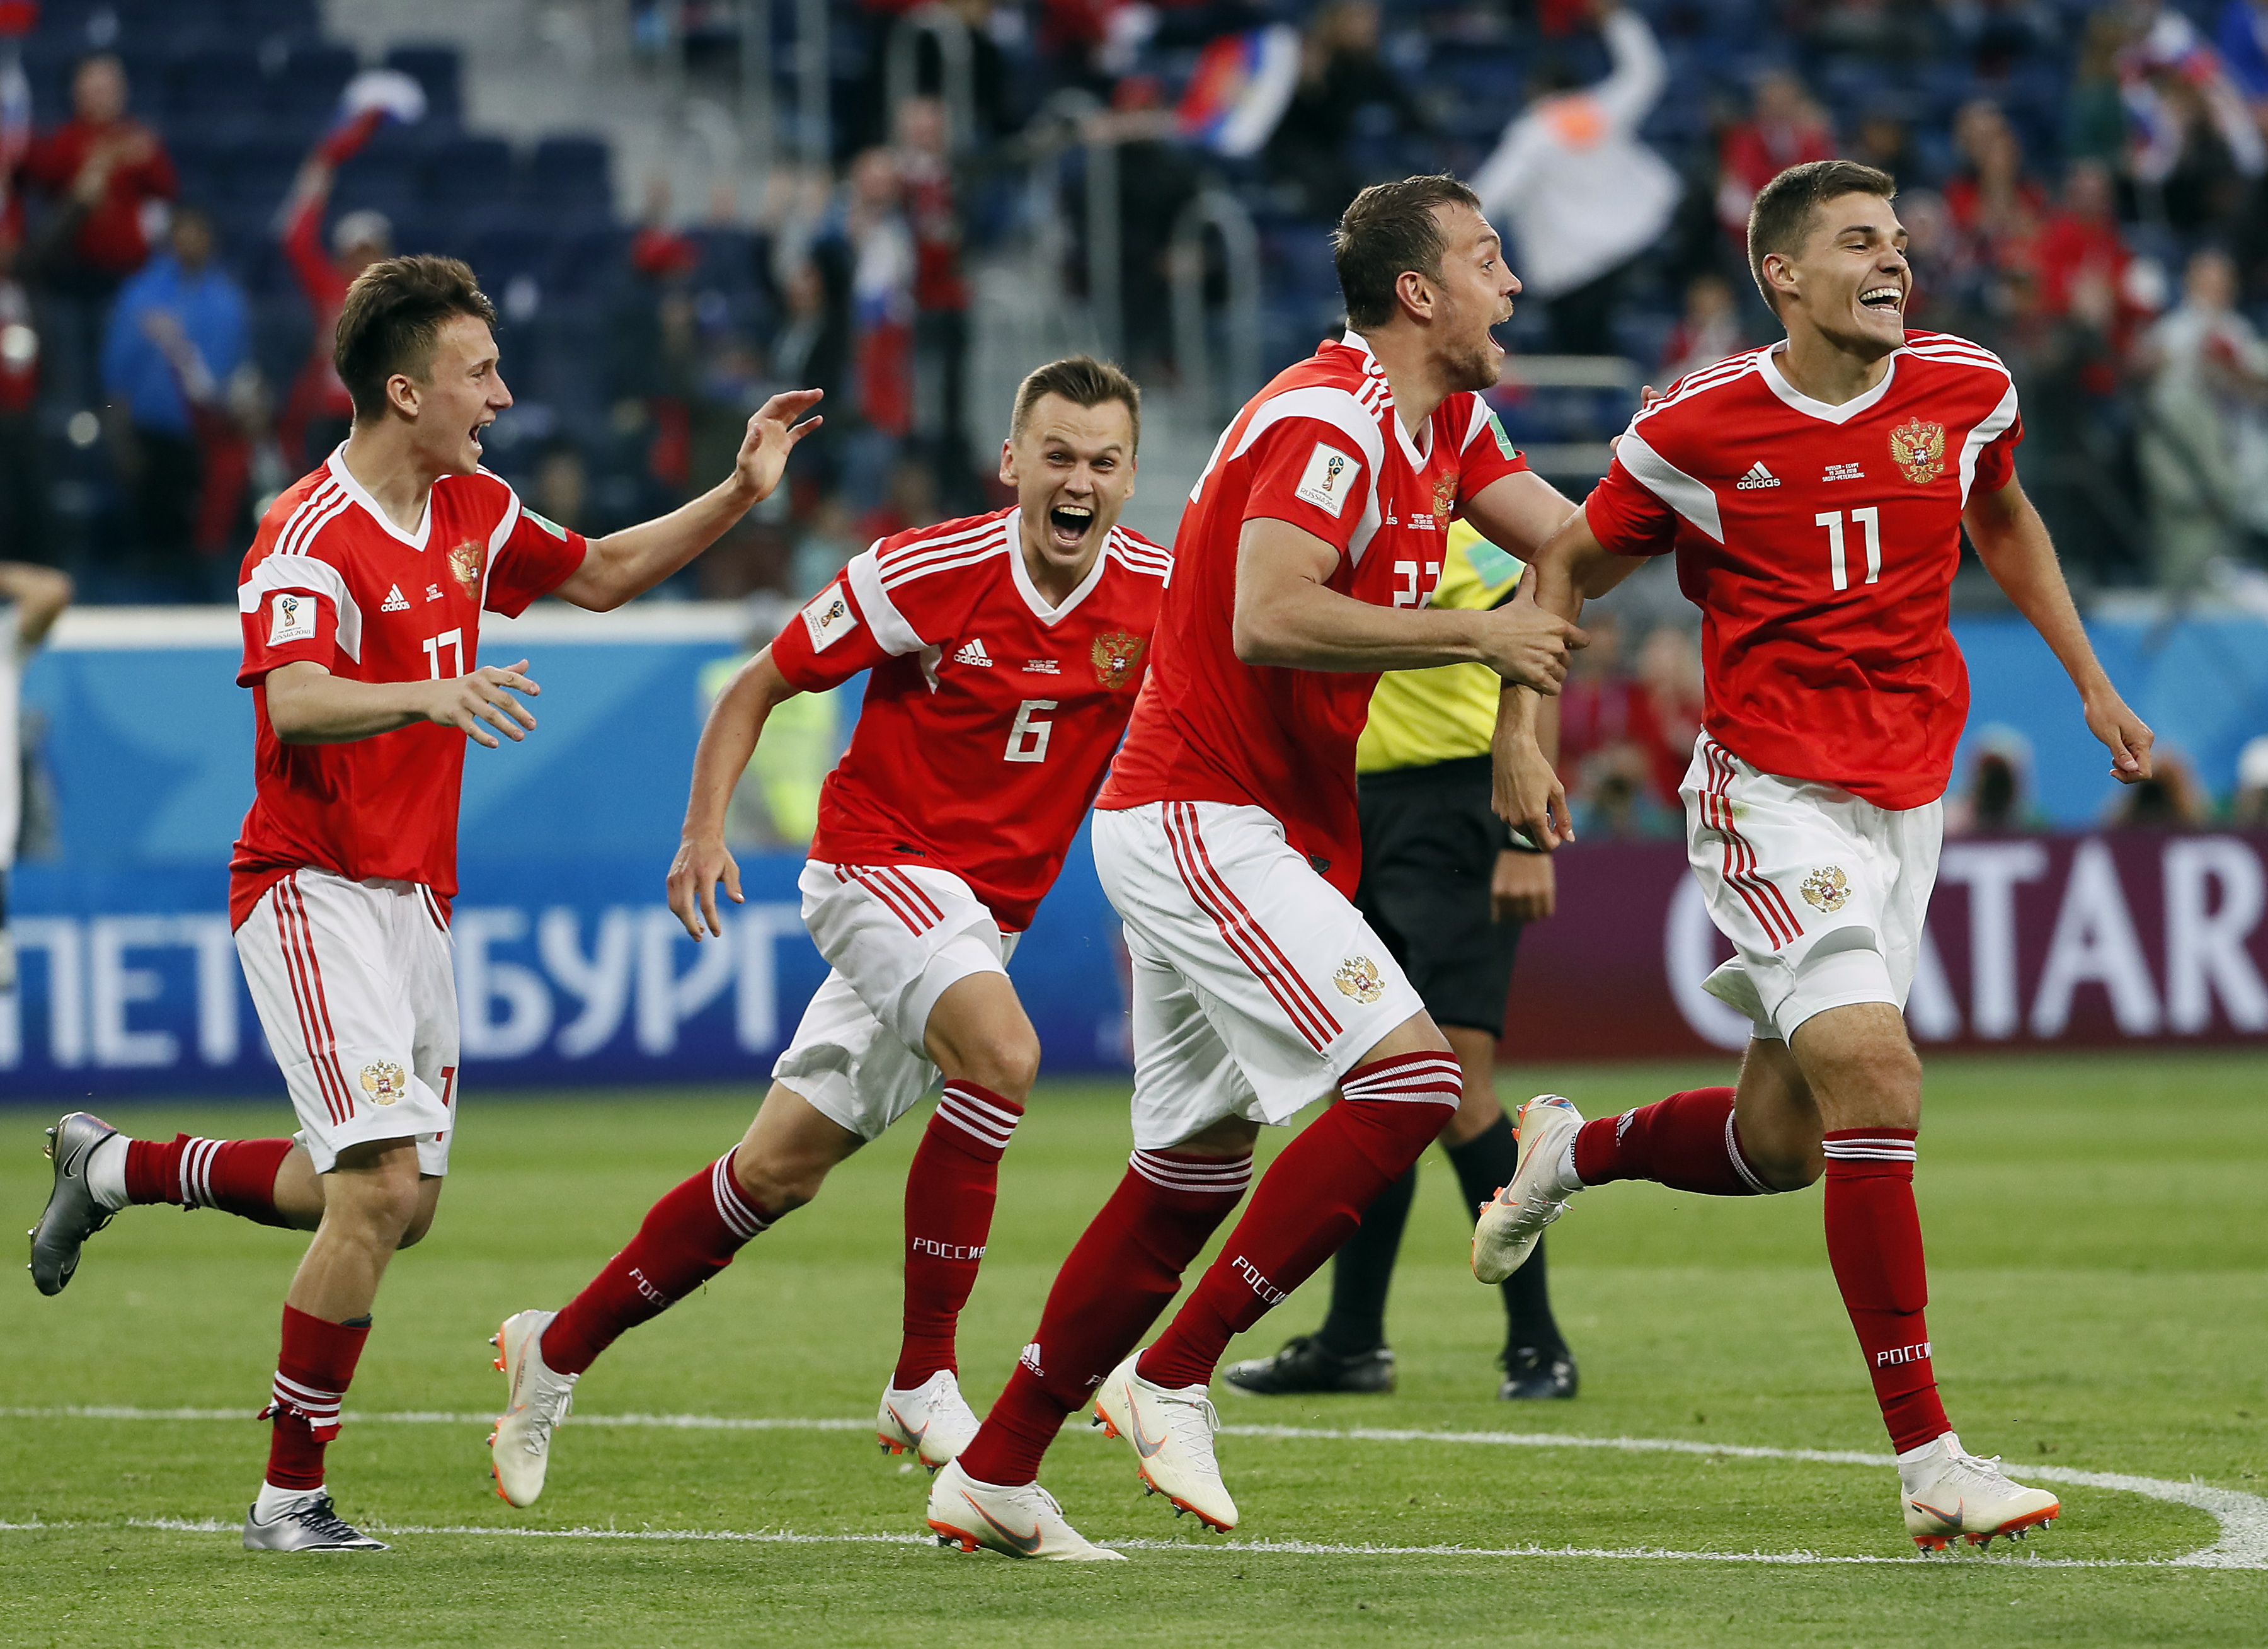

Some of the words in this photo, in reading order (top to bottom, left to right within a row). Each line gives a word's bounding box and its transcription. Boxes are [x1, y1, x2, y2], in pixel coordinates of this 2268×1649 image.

[1300, 488, 1325, 503] RUSSIA
[1736, 478, 1781, 490] adidas
[1815, 506, 1881, 591] 11
[381, 600, 411, 612] adidas
[272, 631, 294, 643] RUSSIA
[423, 627, 464, 680] 17
[953, 654, 993, 667] adidas
[1004, 699, 1058, 763] 6
[1663, 836, 2268, 1051] TAR
[0, 907, 813, 1065] ПЕТБУРГ
[913, 1237, 987, 1260] РОССИЯ
[1232, 1255, 1290, 1306] РОССИ
